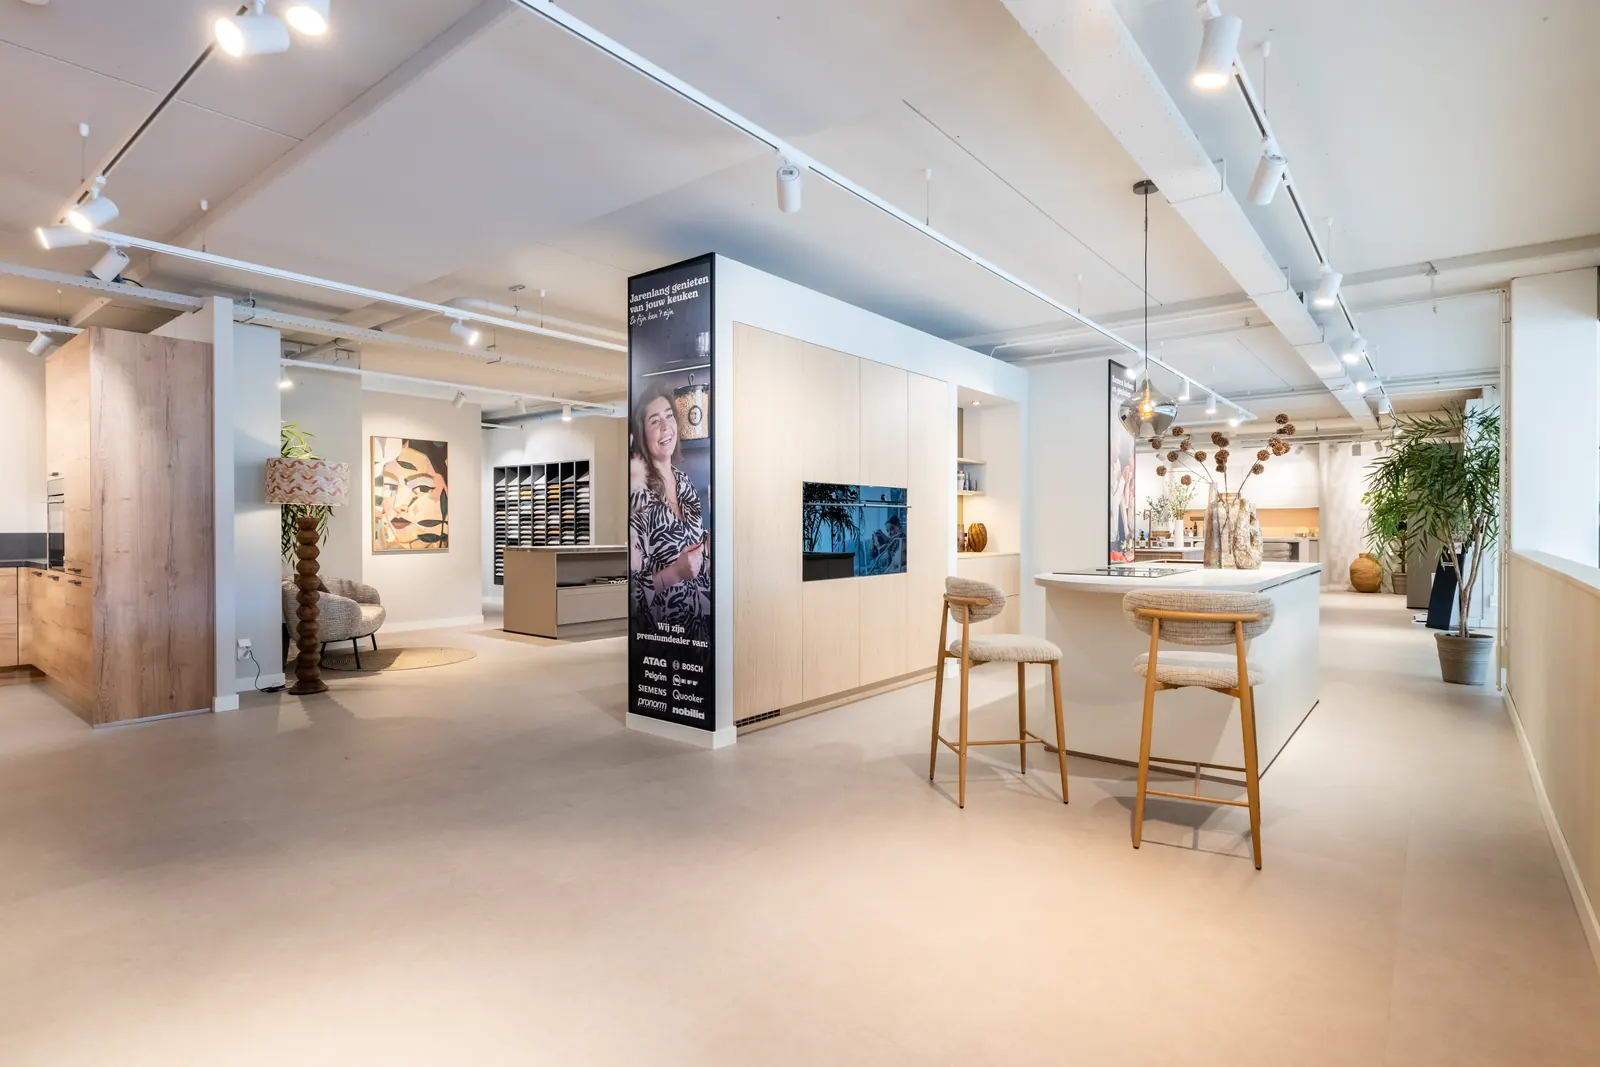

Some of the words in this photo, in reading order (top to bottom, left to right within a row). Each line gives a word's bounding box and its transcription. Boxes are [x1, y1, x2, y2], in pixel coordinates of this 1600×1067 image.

[629, 285, 671, 303] Jarenlang
[671, 276, 709, 294] genieten
[629, 304, 644, 314] van
[645, 299, 666, 312] jouw
[667, 290, 699, 305] keuken
[637, 313, 647, 326] fijn
[663, 308, 674, 320] zijn
[657, 622, 670, 633] Wij
[671, 624, 685, 634] zijn
[636, 632, 691, 646] premiumdealer
[692, 639, 708, 648] van:
[642, 656, 668, 668] ATAG
[682, 662, 704, 673] BOSCH
[644, 669, 668, 682] Pelgrim
[637, 684, 667, 697] SIEMENS
[672, 689, 704, 704] Quooker
[637, 697, 668, 710] pronorm
[672, 706, 705, 720] nobilia
